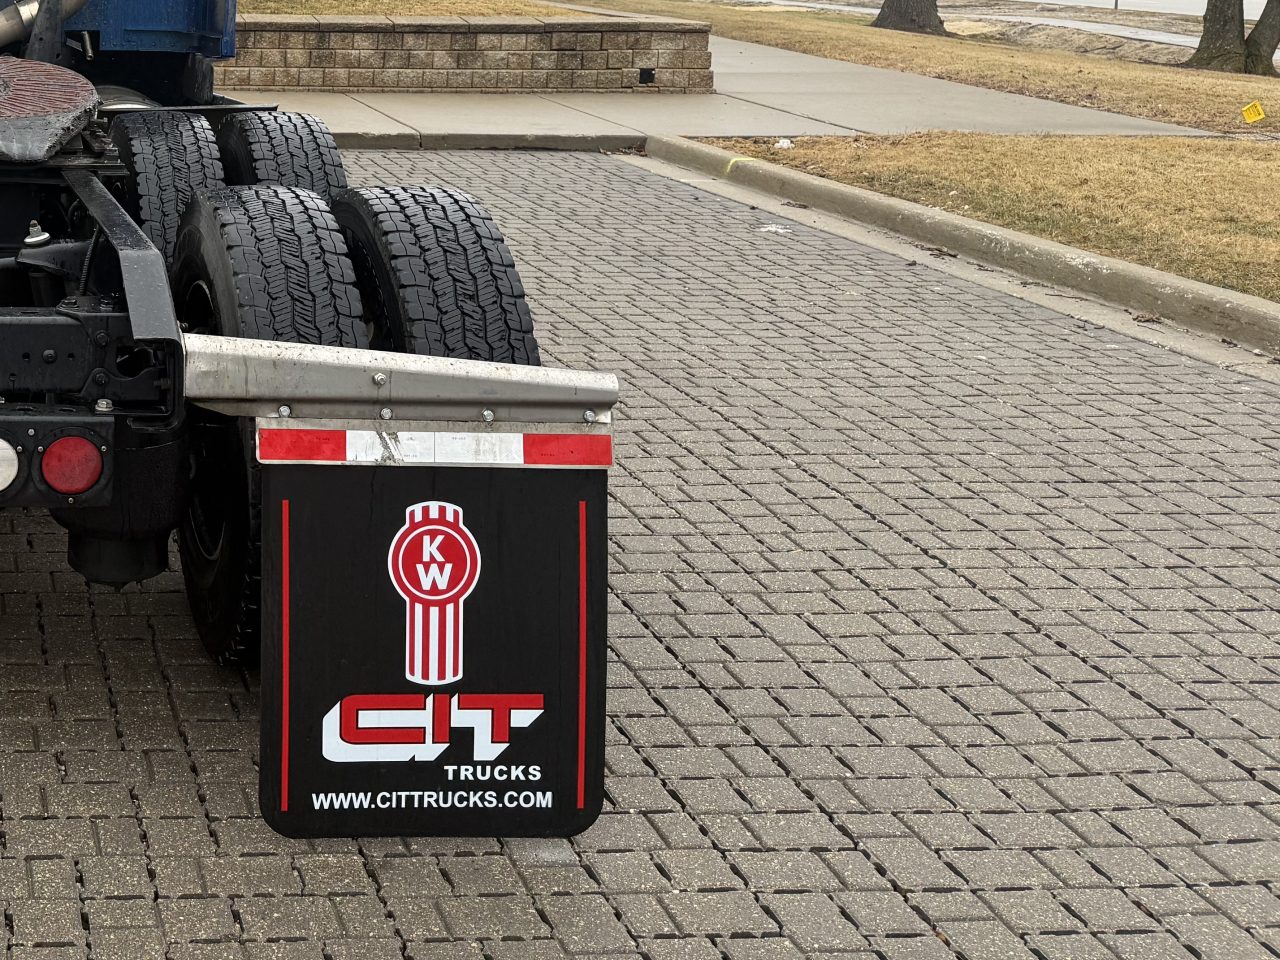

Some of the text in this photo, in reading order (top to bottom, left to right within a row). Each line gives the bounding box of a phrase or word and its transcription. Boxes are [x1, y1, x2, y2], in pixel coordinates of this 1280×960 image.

[322, 693, 545, 762] CIT
[444, 765, 542, 782] TRUCKS
[311, 790, 554, 810] WWW.CITTRUCKS.COM
